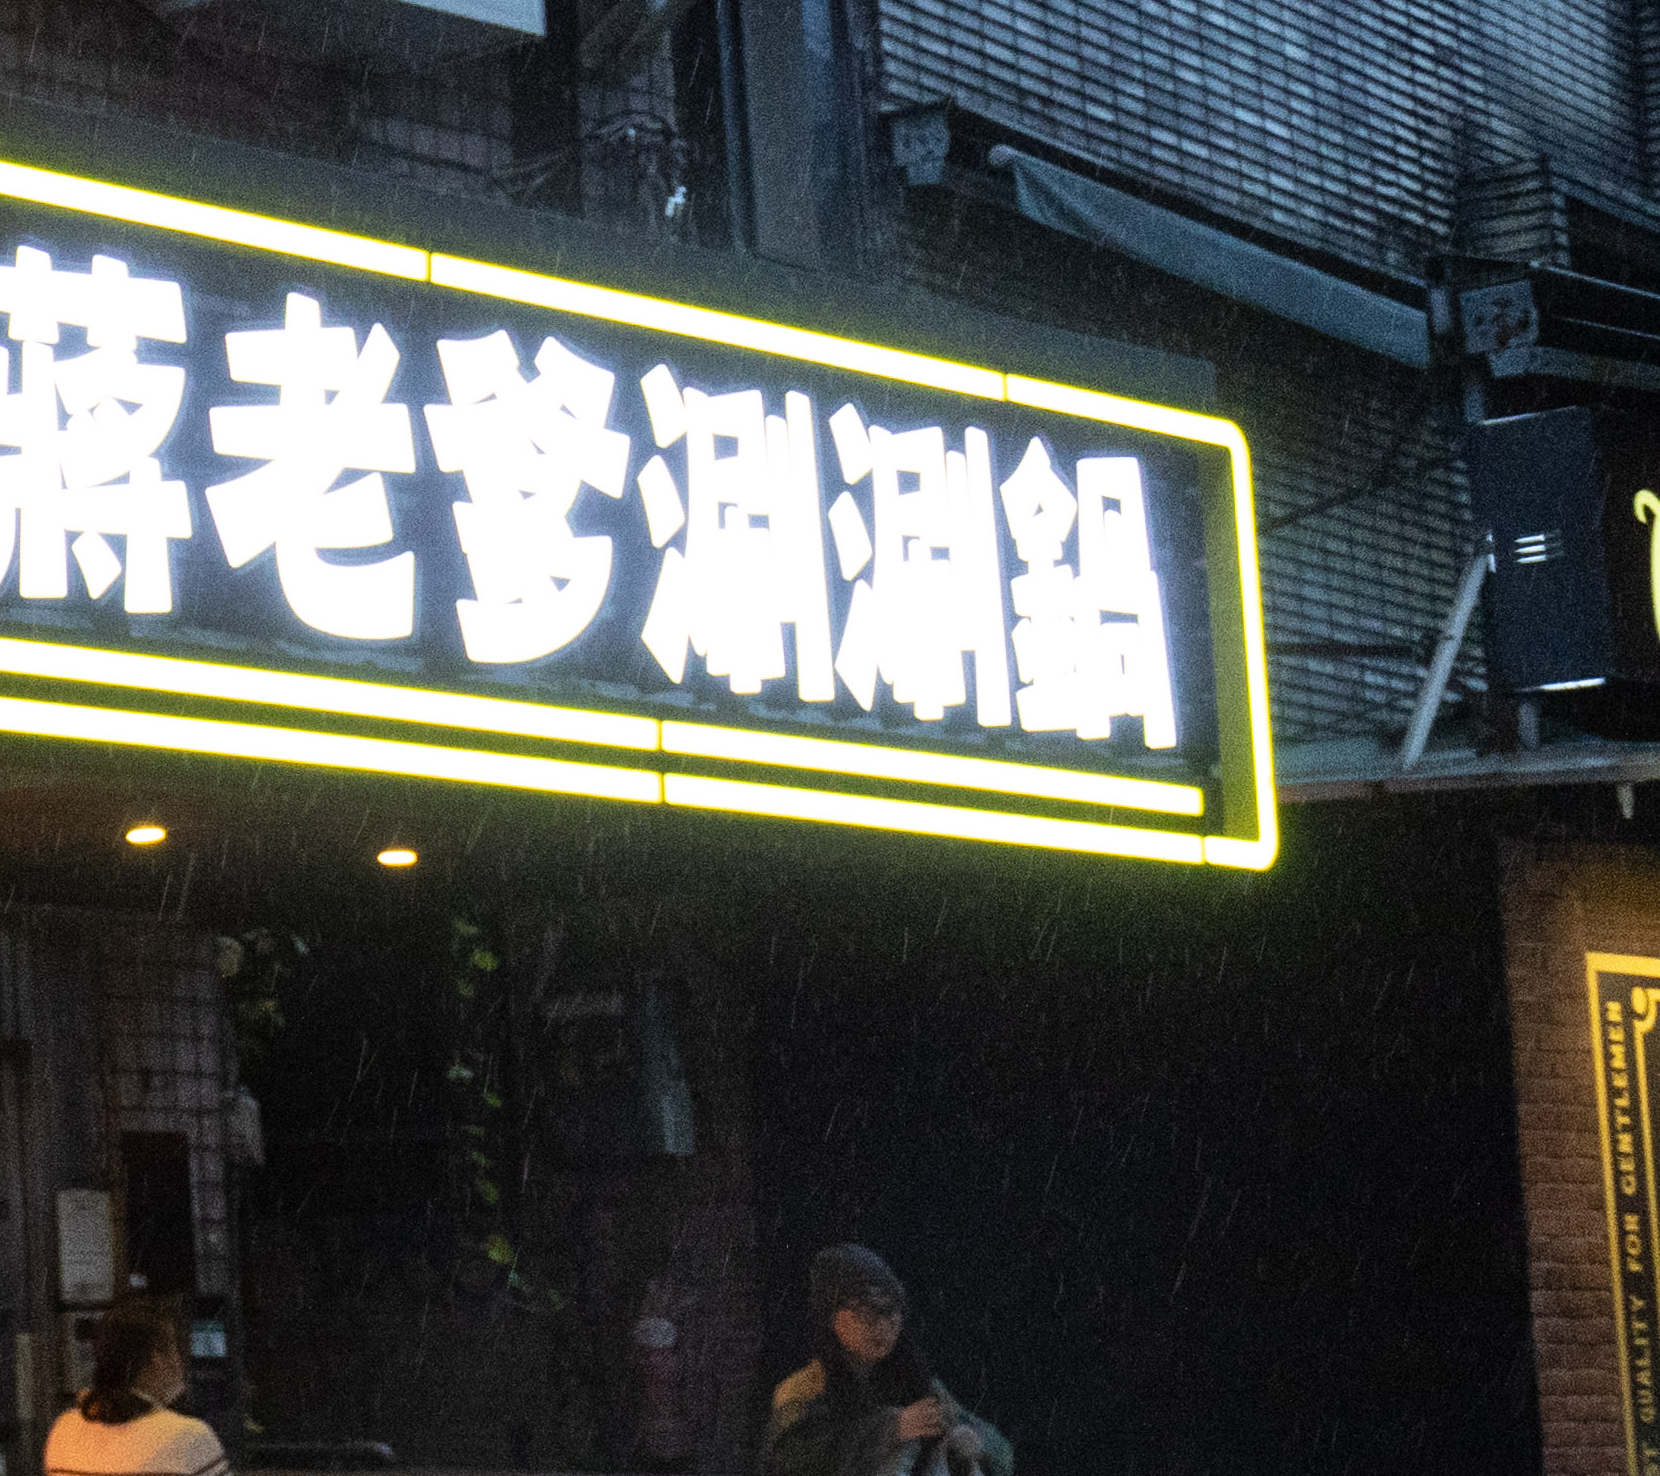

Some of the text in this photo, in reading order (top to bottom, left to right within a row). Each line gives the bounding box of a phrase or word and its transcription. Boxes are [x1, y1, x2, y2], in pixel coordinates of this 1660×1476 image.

[1606, 1001, 1638, 1196] GENTLEMEN
[1624, 1213, 1644, 1274] FOR
[1632, 1297, 1659, 1424] QUALITY
